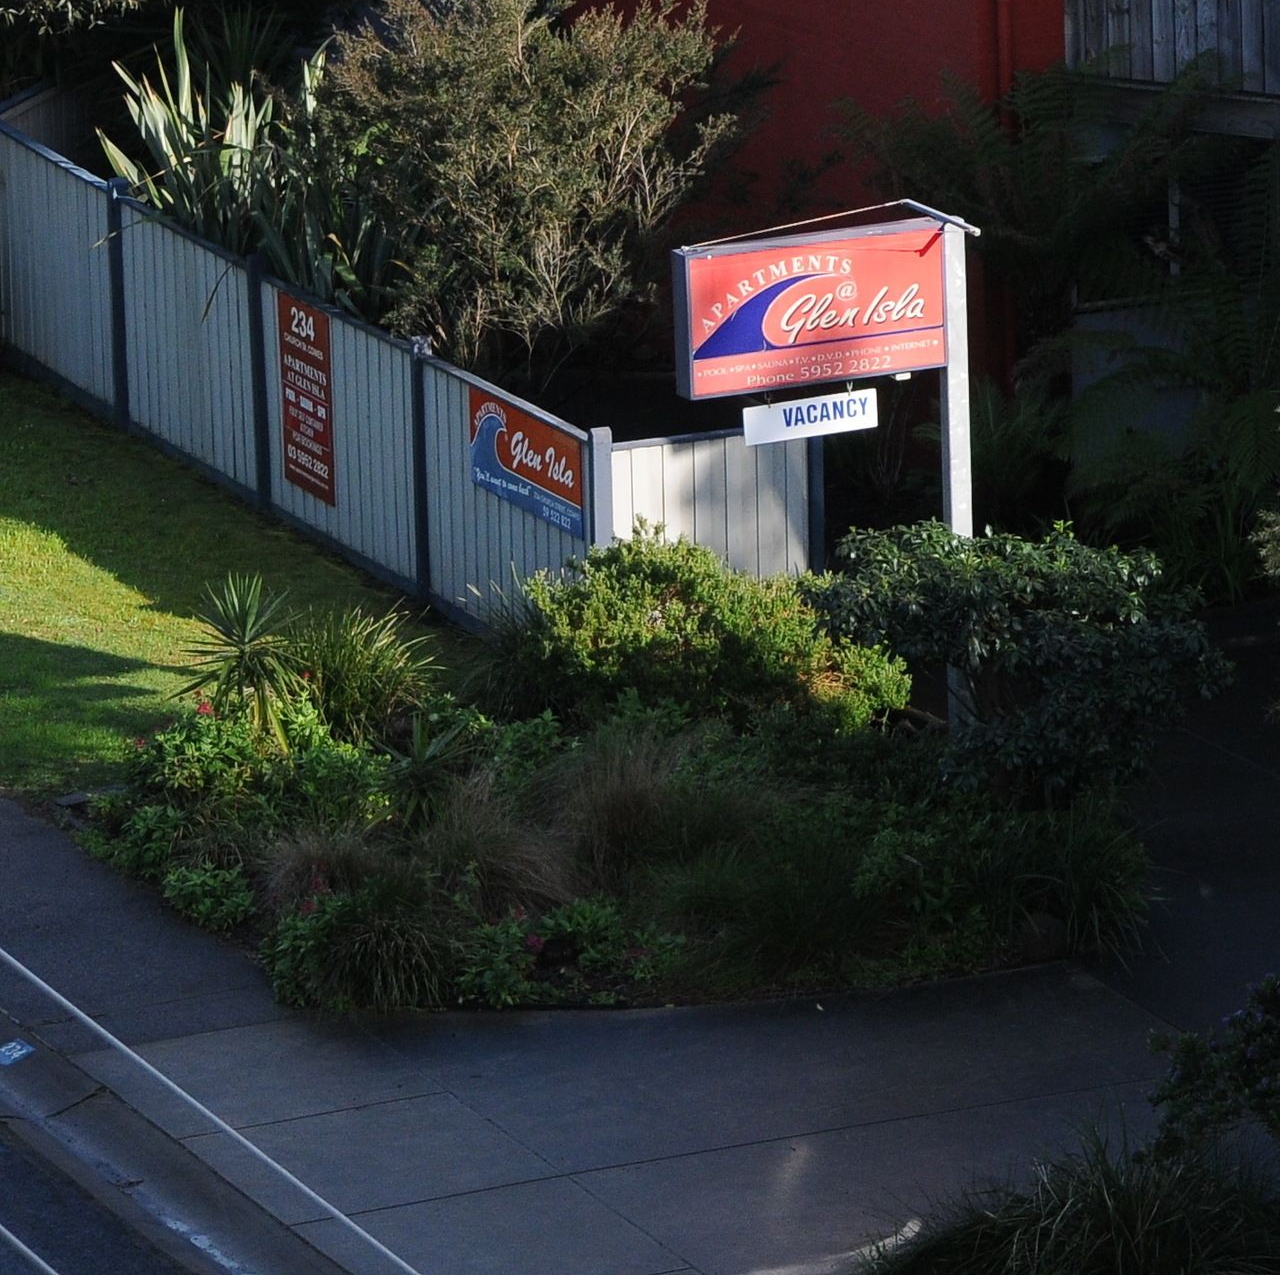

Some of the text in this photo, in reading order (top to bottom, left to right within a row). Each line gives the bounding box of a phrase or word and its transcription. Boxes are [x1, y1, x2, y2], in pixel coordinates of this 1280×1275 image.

[702, 255, 853, 334] APARTMENTS
[836, 281, 857, 301] @
[290, 306, 315, 342] 234
[781, 283, 925, 344] Glen Isla
[284, 353, 327, 386] APARTMENTS
[747, 355, 892, 385] Phone 5952 2822
[757, 360, 788, 371] SAUNA
[891, 340, 931, 351] INTERNET
[474, 402, 507, 425] APARTMENTS
[783, 397, 867, 427] VACANCY
[511, 431, 575, 488] Glen Isla
